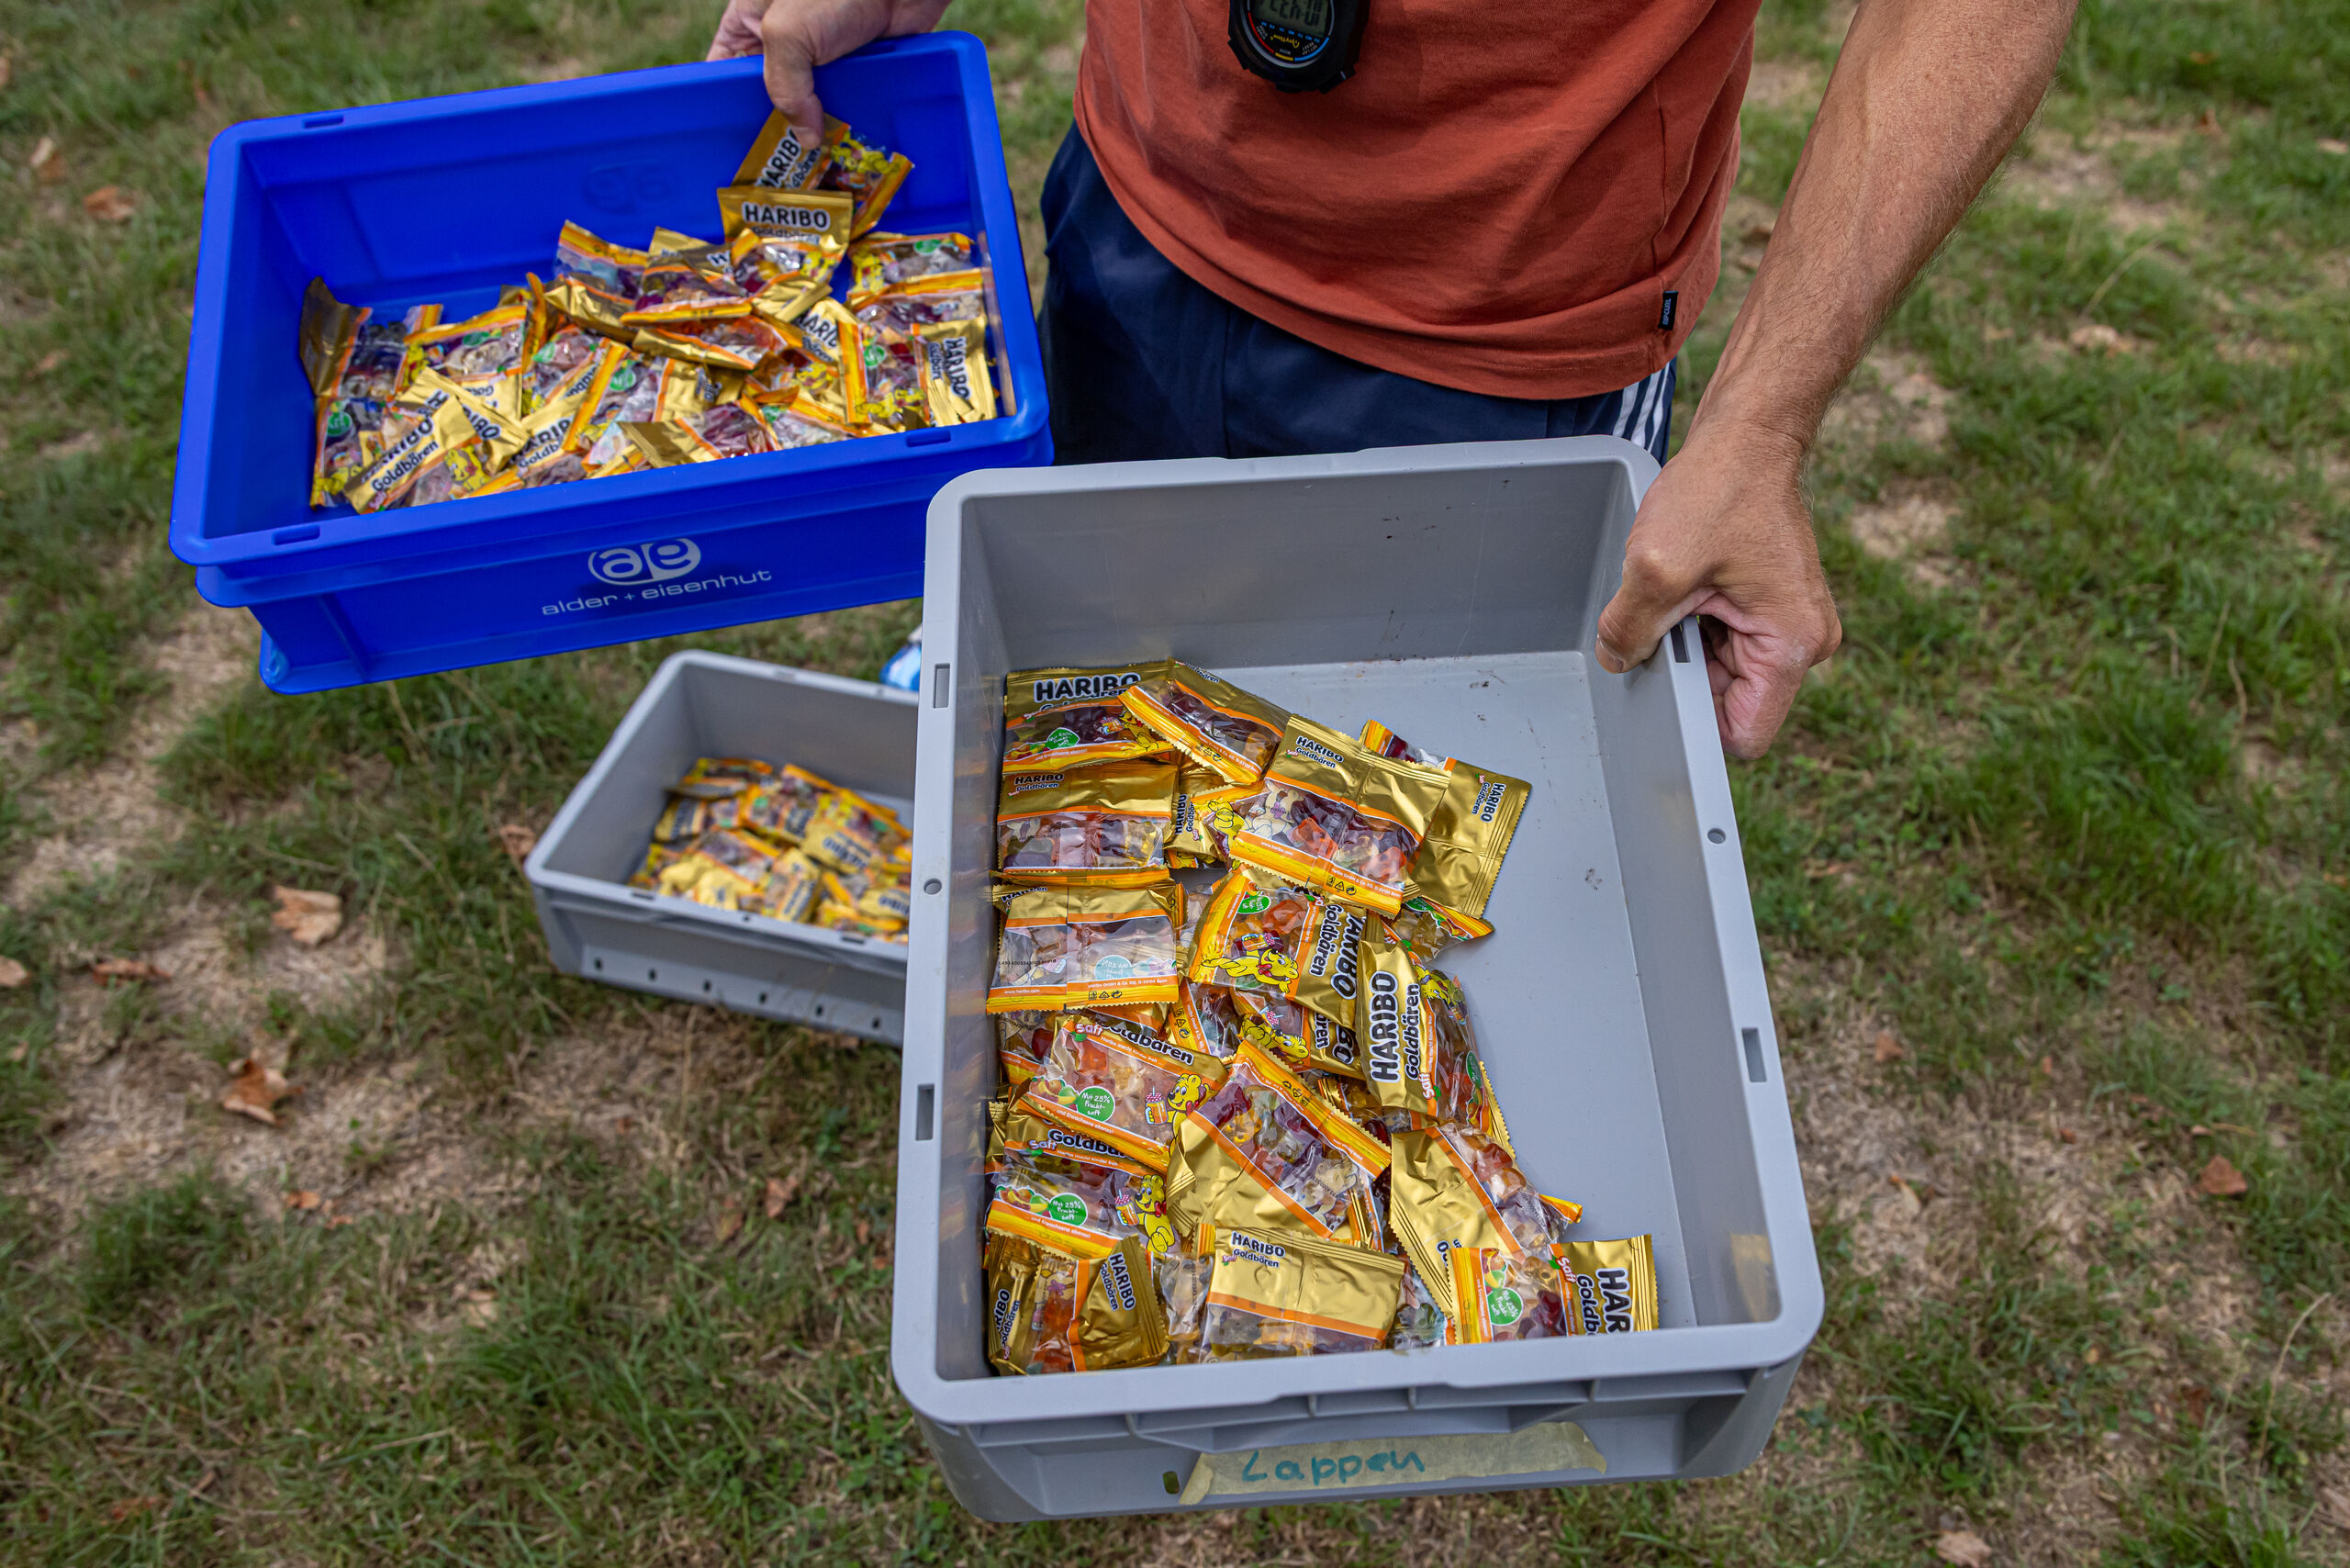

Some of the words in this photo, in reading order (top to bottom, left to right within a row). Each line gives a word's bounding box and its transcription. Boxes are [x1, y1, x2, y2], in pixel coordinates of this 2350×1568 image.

[742, 201, 831, 230] HARIBO
[371, 441, 440, 492] Goldbären
[542, 593, 618, 616] alder
[642, 569, 773, 599] eisenhut
[1034, 672, 1141, 703] HARIBO
[1295, 735, 1345, 763] HARIBO
[1296, 747, 1337, 768] Goldbären
[1014, 773, 1065, 785] HARIBO
[1016, 783, 1059, 791] Goldbären
[1472, 782, 1491, 815] Goldbären
[1480, 783, 1505, 823] HARIBO
[1309, 903, 1344, 977] Goldbären
[1074, 1023, 1103, 1036] Saft
[1370, 970, 1401, 1083] HARIBO
[1401, 982, 1420, 1081] Goldbären
[1081, 1092, 1093, 1101] Mit
[1094, 1093, 1110, 1104] 25%
[1419, 1072, 1435, 1100] Saft
[1028, 1139, 1058, 1150] Saft
[1065, 1201, 1081, 1209] 25%
[1232, 1232, 1285, 1257] HARIBO
[1233, 1249, 1280, 1268] Goldbären
[1109, 1253, 1136, 1310] HARIBO
[1558, 1257, 1576, 1282] Saft
[1101, 1263, 1119, 1311] Goldbären
[1241, 1450, 1426, 1486] Lappen
